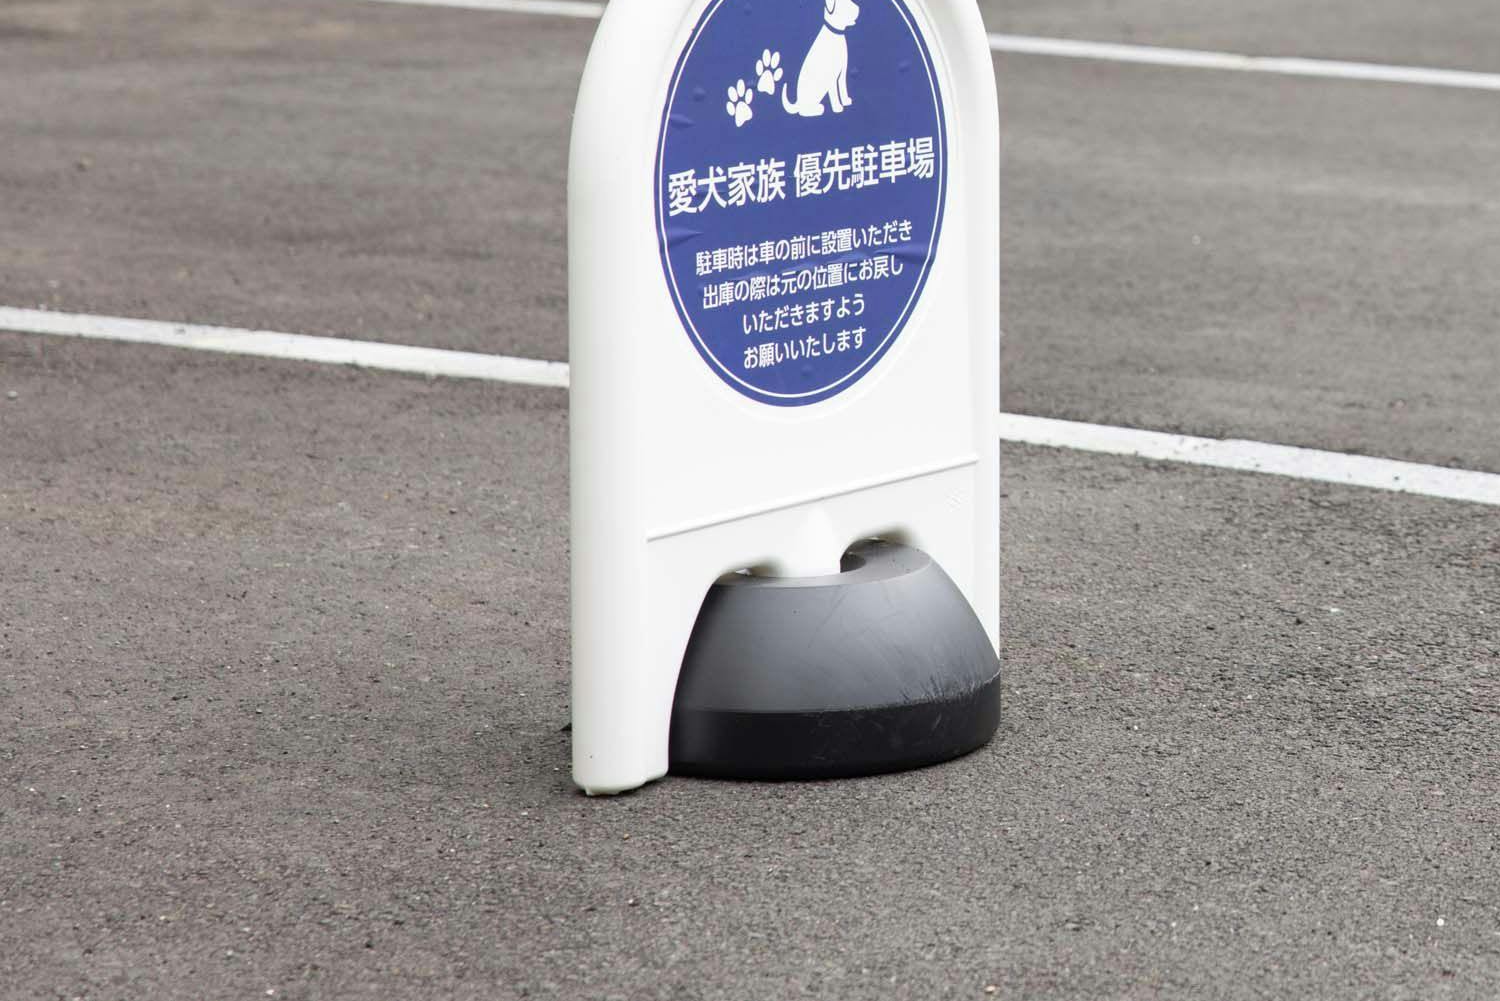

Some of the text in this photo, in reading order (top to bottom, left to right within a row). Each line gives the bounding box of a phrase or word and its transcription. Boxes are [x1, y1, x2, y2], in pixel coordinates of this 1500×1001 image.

[668, 136, 935, 217] 愛犬家族 優先駐車場
[695, 219, 913, 276] 駐車時は車の前に設置いただき
[703, 254, 904, 310] 出庫の際は元の位置にお戻し
[742, 292, 866, 335] いただきますよう
[743, 325, 867, 369] お願いいたします
